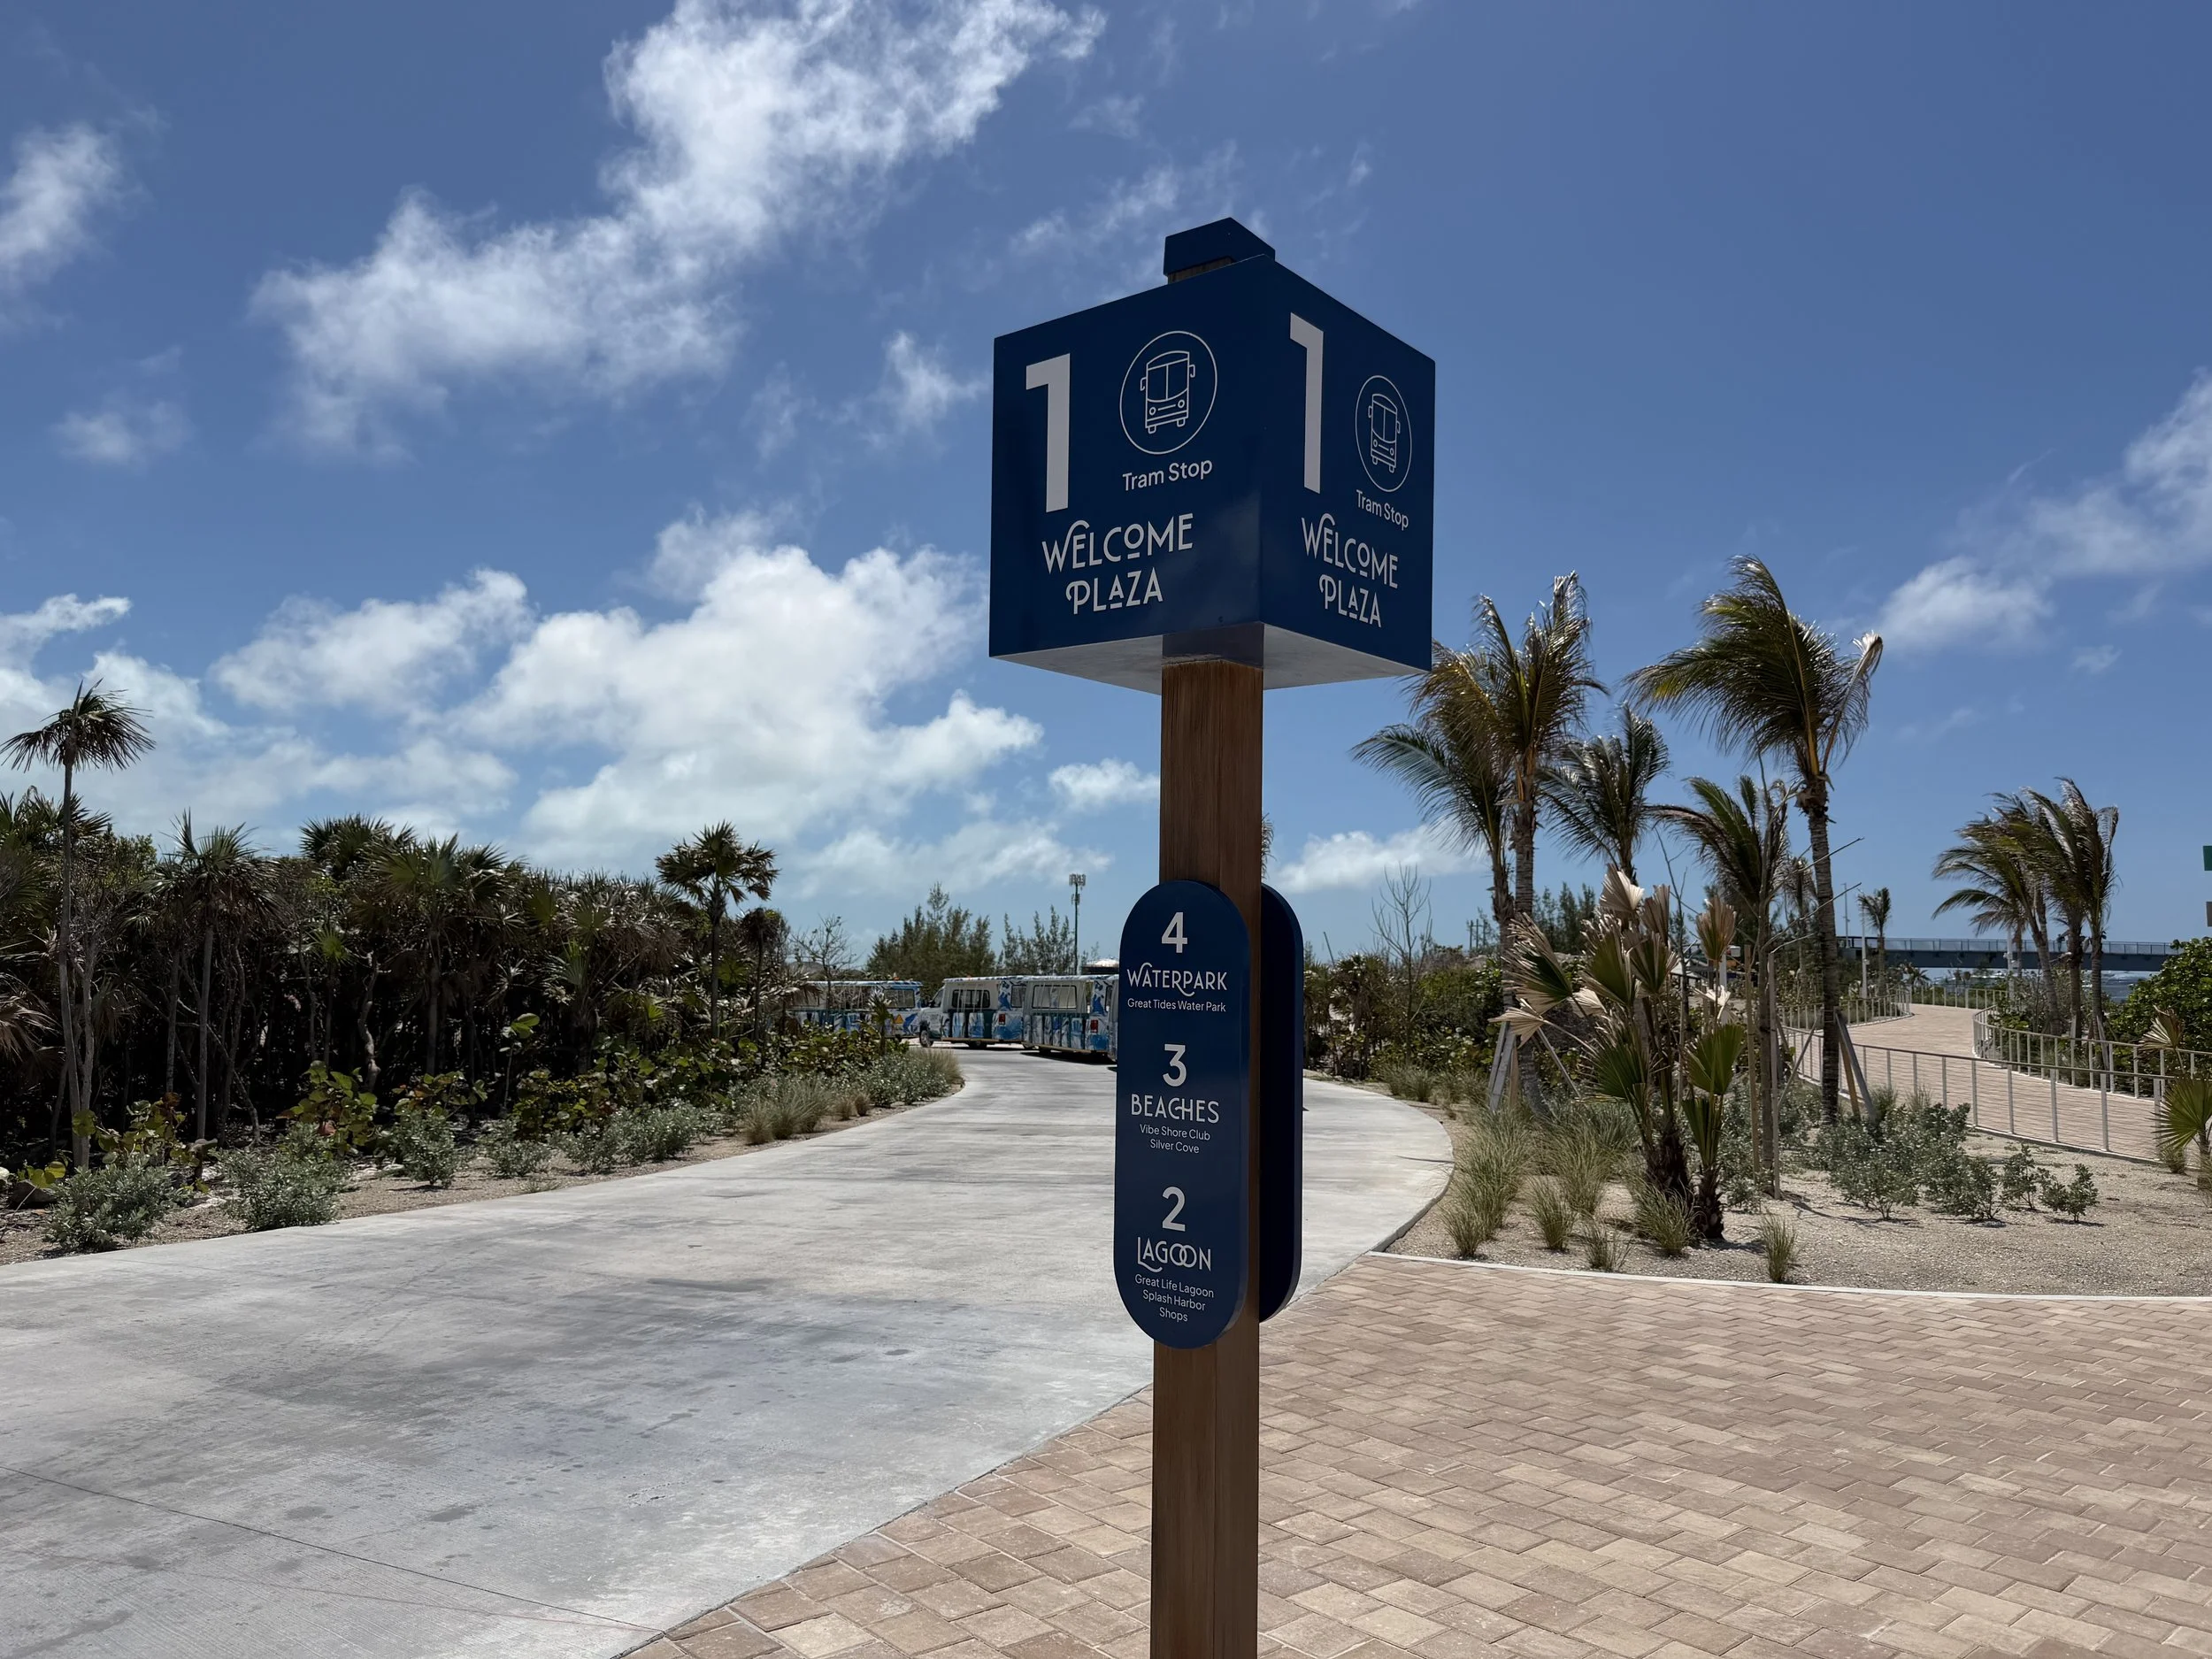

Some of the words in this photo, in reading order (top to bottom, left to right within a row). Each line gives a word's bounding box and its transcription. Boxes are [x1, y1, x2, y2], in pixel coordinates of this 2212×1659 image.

[1289, 311, 1324, 494] 1
[1025, 352, 1070, 512] 1
[1122, 470, 1164, 490] Tram
[1168, 459, 1212, 480] Stop
[1356, 488, 1382, 518] Tram
[1383, 502, 1409, 531] Stop
[1041, 512, 1193, 573] WELCOME
[1301, 512, 1398, 588] WELCOME
[1065, 566, 1163, 614] PLAZA
[1318, 573, 1381, 627] PLAZA
[1161, 911, 1188, 953] 4
[1126, 962, 1226, 996] WATERPARK
[1127, 997, 1152, 1008] Great
[1153, 999, 1176, 1010] Tides
[1177, 1000, 1204, 1010] Water
[1205, 1001, 1226, 1011] Park
[1162, 1043, 1187, 1087] 3
[1131, 1094, 1218, 1123] BEACHES
[1139, 1124, 1160, 1134] Vibe
[1161, 1125, 1187, 1137] Shore
[1188, 1128, 1210, 1141] Club
[1149, 1138, 1174, 1149] Silver
[1175, 1141, 1200, 1153] Cove
[1162, 1186, 1186, 1232] 2
[1137, 1236, 1210, 1271] LAGOON
[1134, 1273, 1160, 1287] Great
[1161, 1279, 1178, 1290] Life
[1179, 1281, 1214, 1297] Lagoon
[1142, 1288, 1172, 1303] Splash
[1173, 1295, 1205, 1310] Harbor
[1159, 1306, 1188, 1322] Shops
